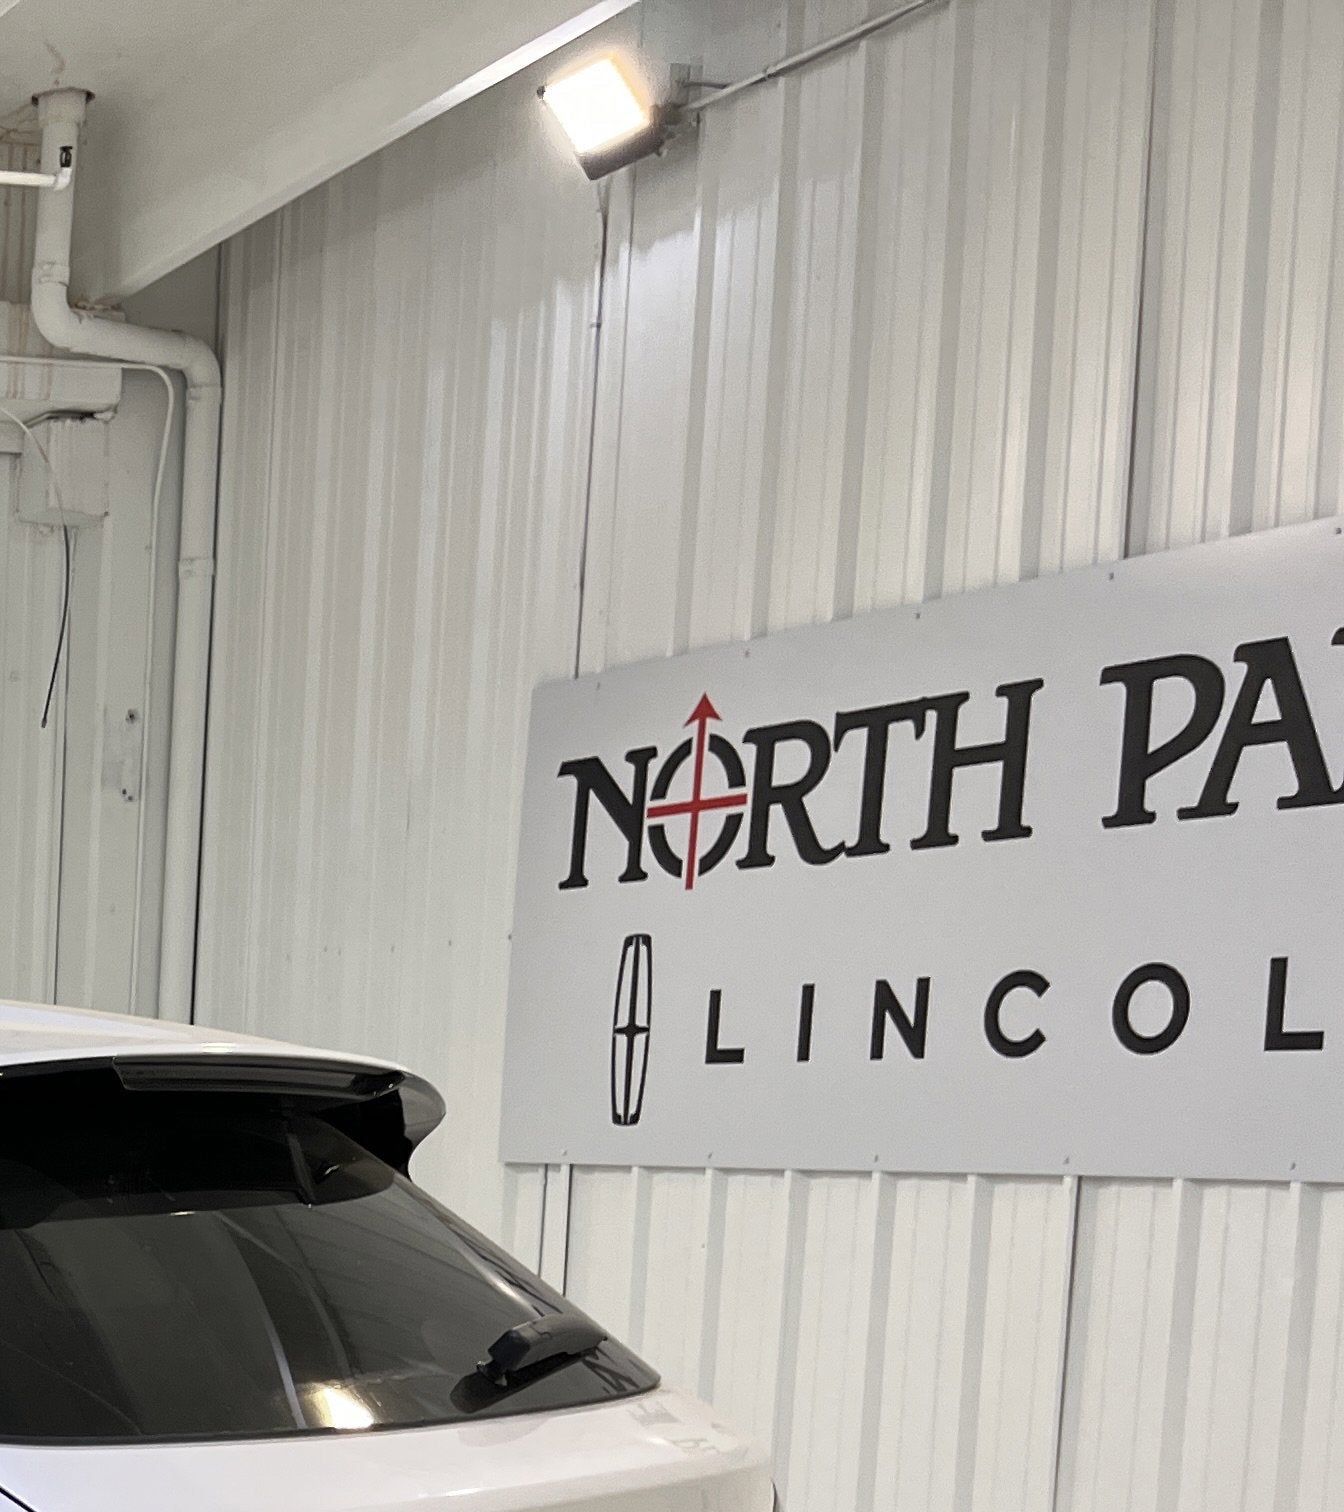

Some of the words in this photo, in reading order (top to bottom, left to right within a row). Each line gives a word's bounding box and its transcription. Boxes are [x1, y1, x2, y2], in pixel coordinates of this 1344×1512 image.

[558, 678, 1044, 891] NORTH
[1100, 626, 1344, 829] PA
[705, 957, 1324, 1065] LINCOL
